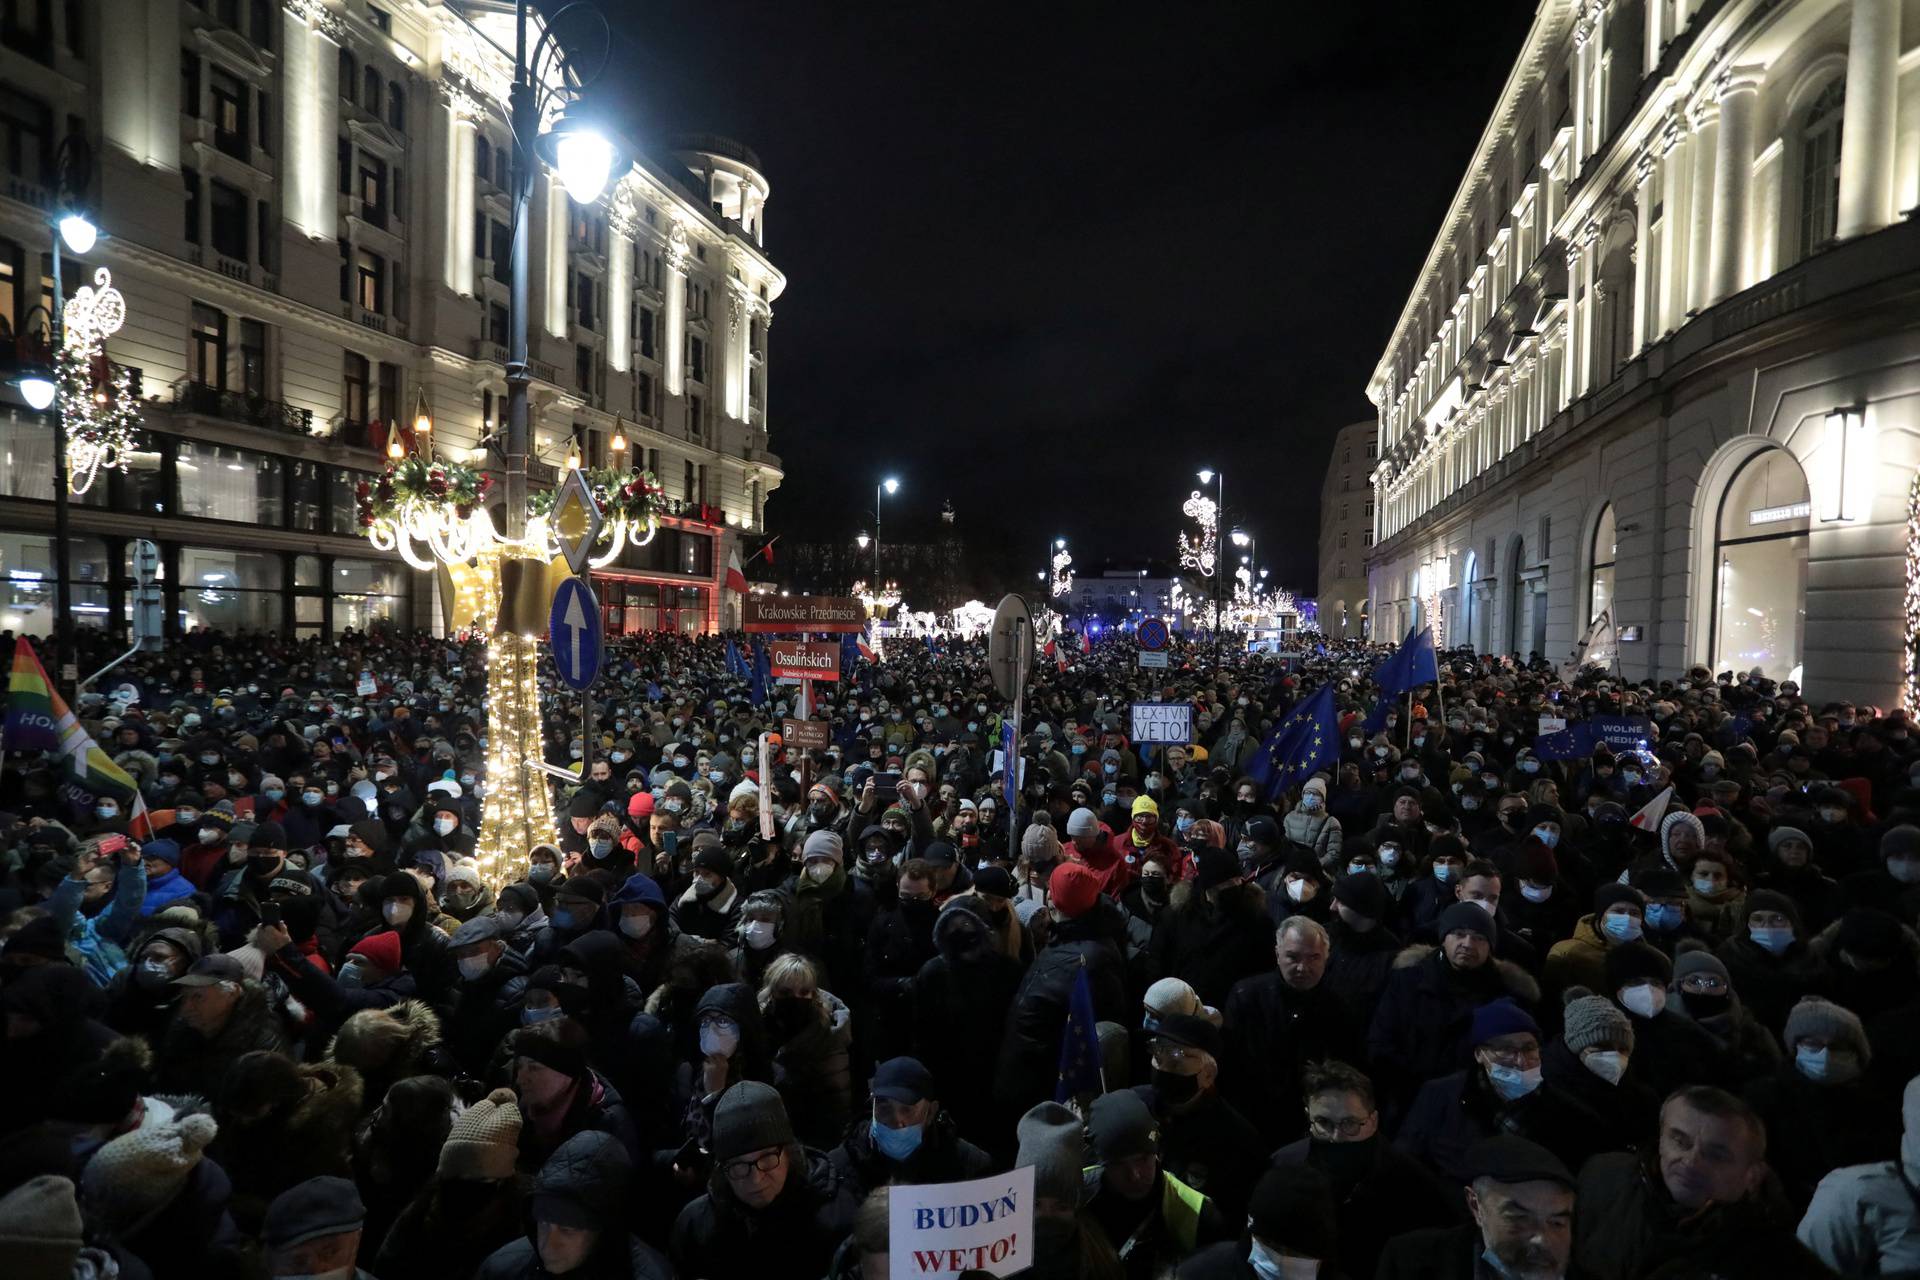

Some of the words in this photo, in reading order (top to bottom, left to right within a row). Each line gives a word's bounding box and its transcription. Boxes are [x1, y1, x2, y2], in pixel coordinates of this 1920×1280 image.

[758, 603, 807, 620] Krakowskie
[810, 606, 856, 620] Przedmieście
[775, 650, 832, 668] Ossolińskich
[1134, 707, 1187, 719] LEX-TVN
[1134, 722, 1188, 741] VETO!
[1602, 724, 1643, 734] WOLNE
[1604, 735, 1639, 744] MEDIA
[914, 1187, 1018, 1230] BUDYŃ
[914, 1233, 1017, 1272] WETO!
